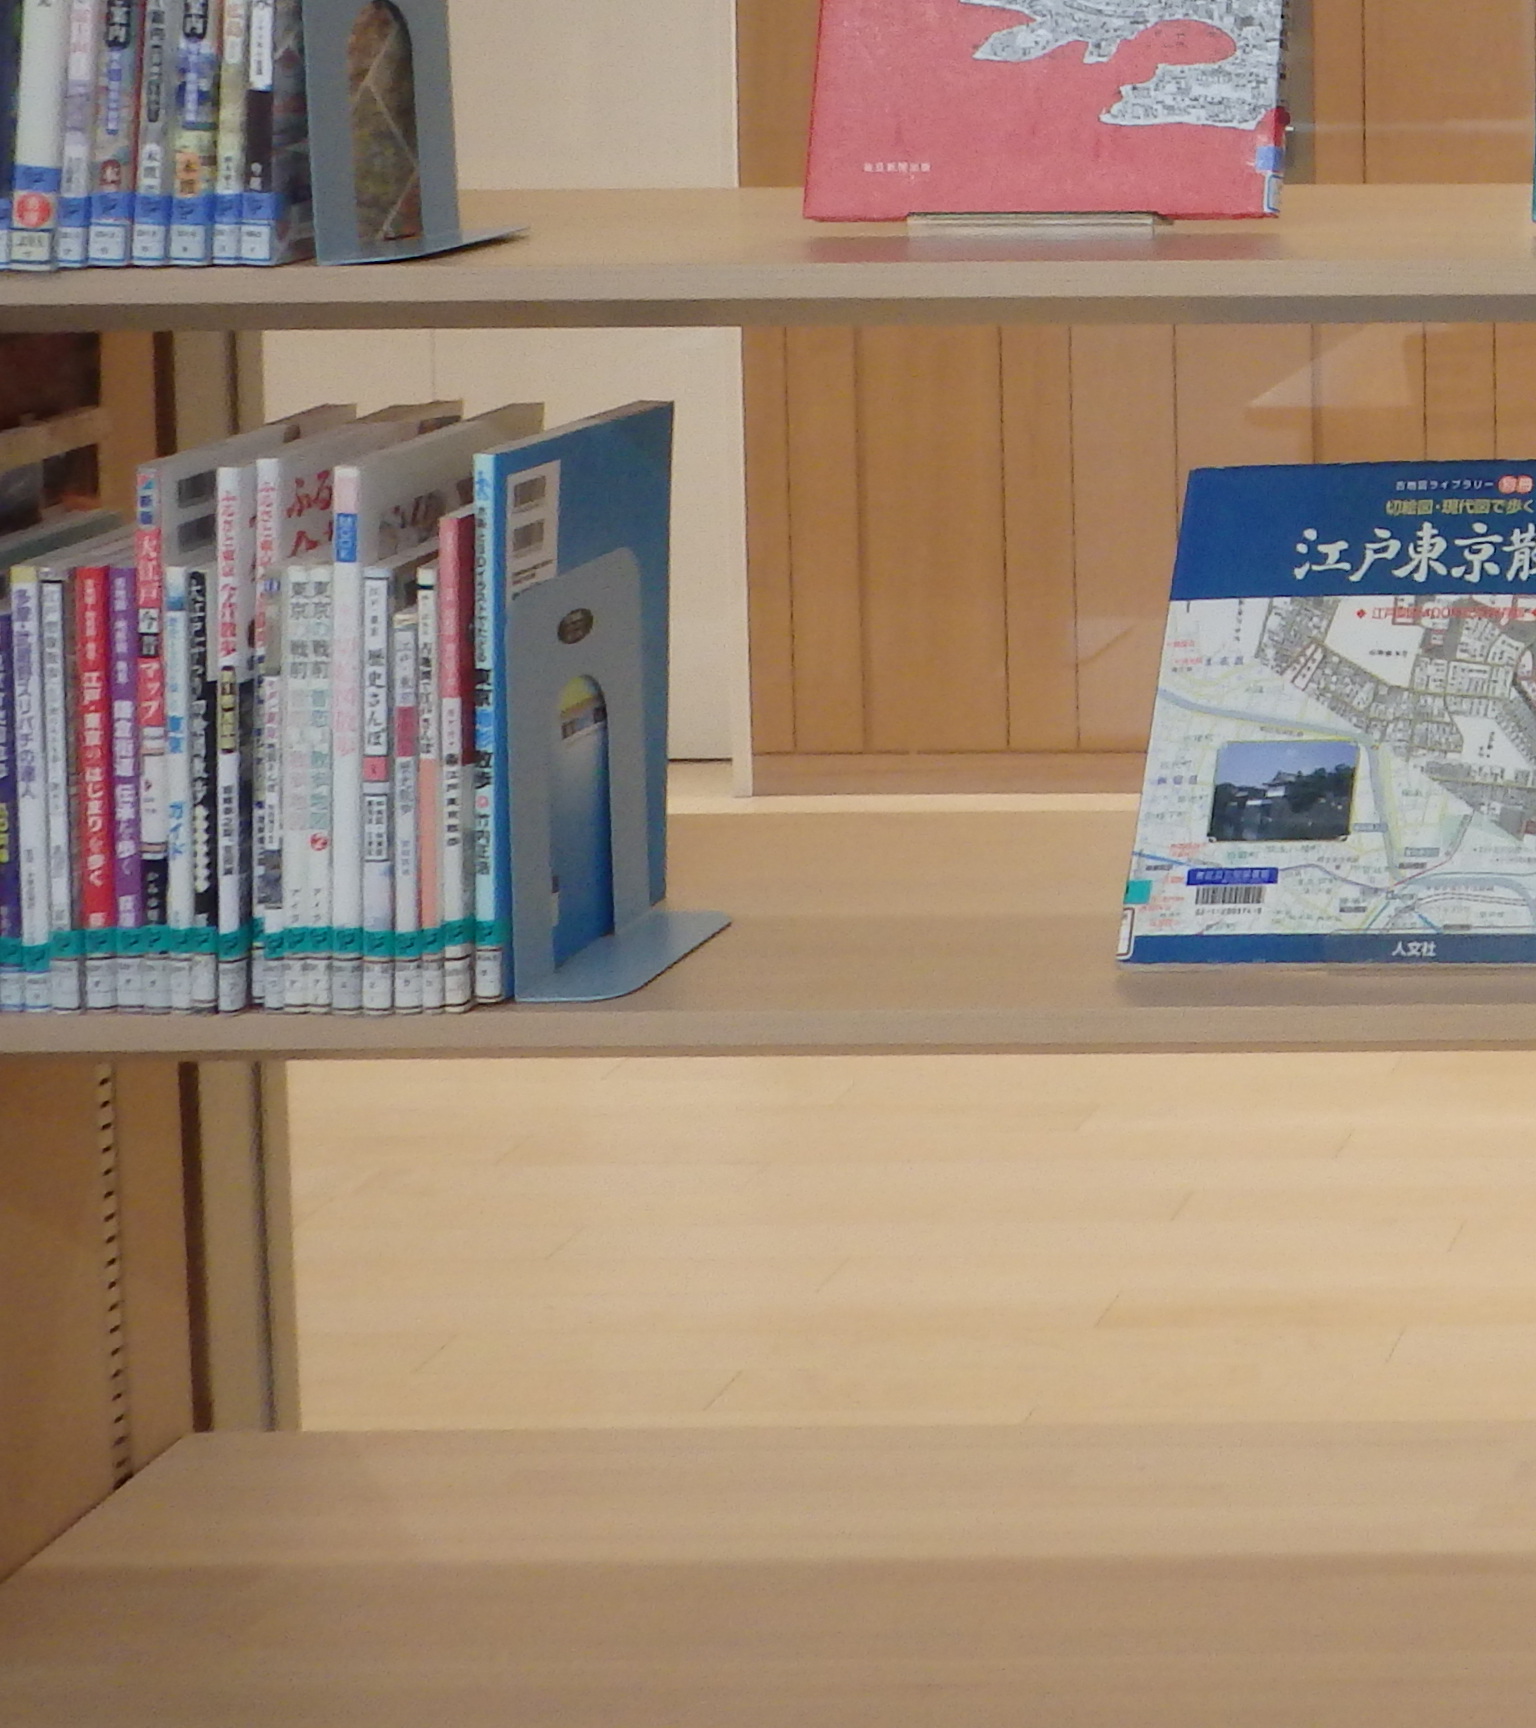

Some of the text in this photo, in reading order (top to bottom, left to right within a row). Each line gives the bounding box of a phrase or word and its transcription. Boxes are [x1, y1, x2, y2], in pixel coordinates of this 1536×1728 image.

[1386, 498, 1535, 516] 切絵図・現代図で歩く
[1391, 941, 1436, 958] 人文社
